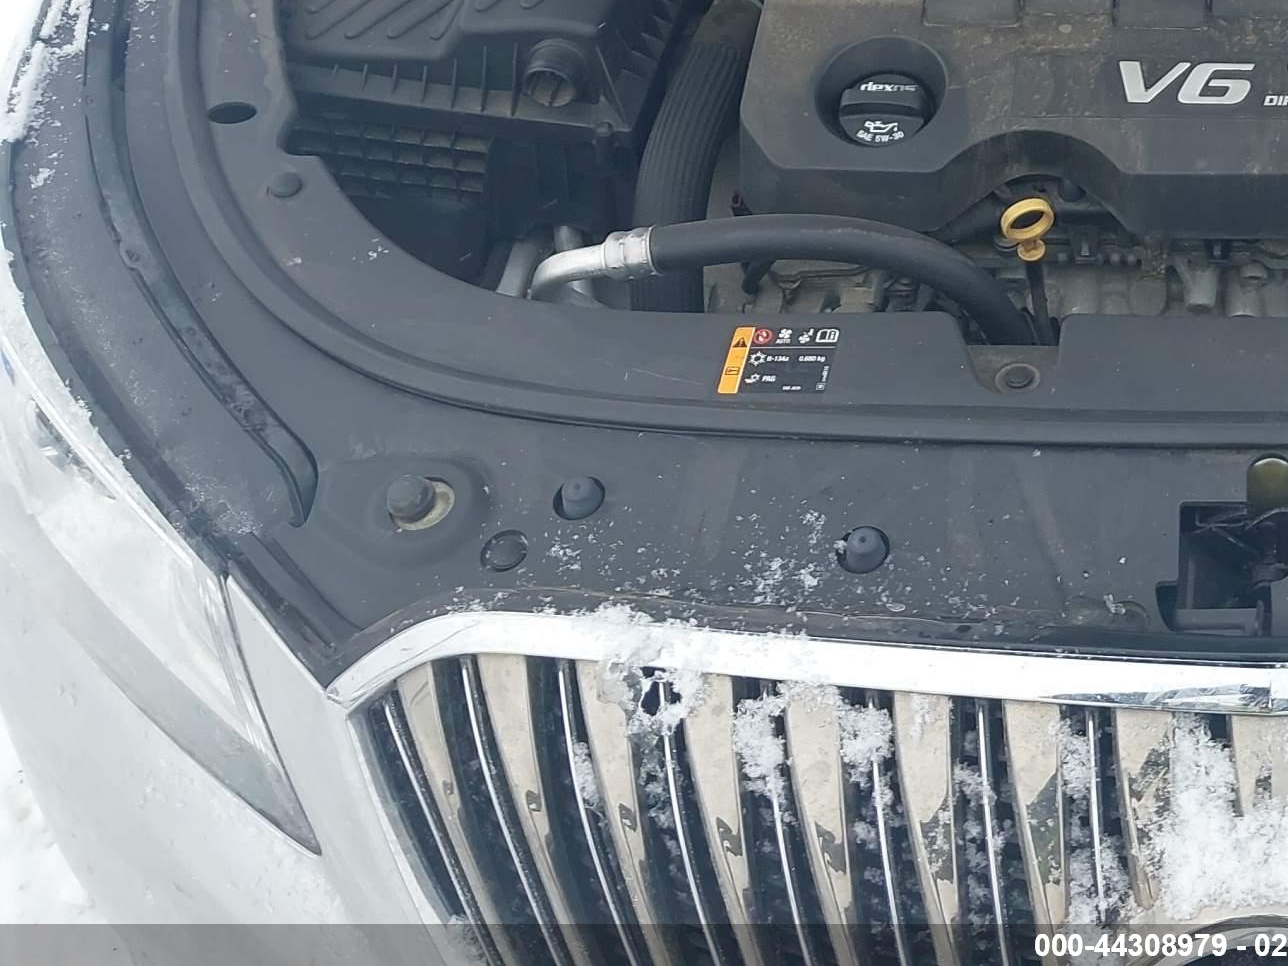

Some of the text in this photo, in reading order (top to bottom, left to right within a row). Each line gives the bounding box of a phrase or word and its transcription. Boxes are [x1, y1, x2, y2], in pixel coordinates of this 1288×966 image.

[1118, 60, 1256, 105] V6
[856, 129, 905, 143] SAE 5W-30
